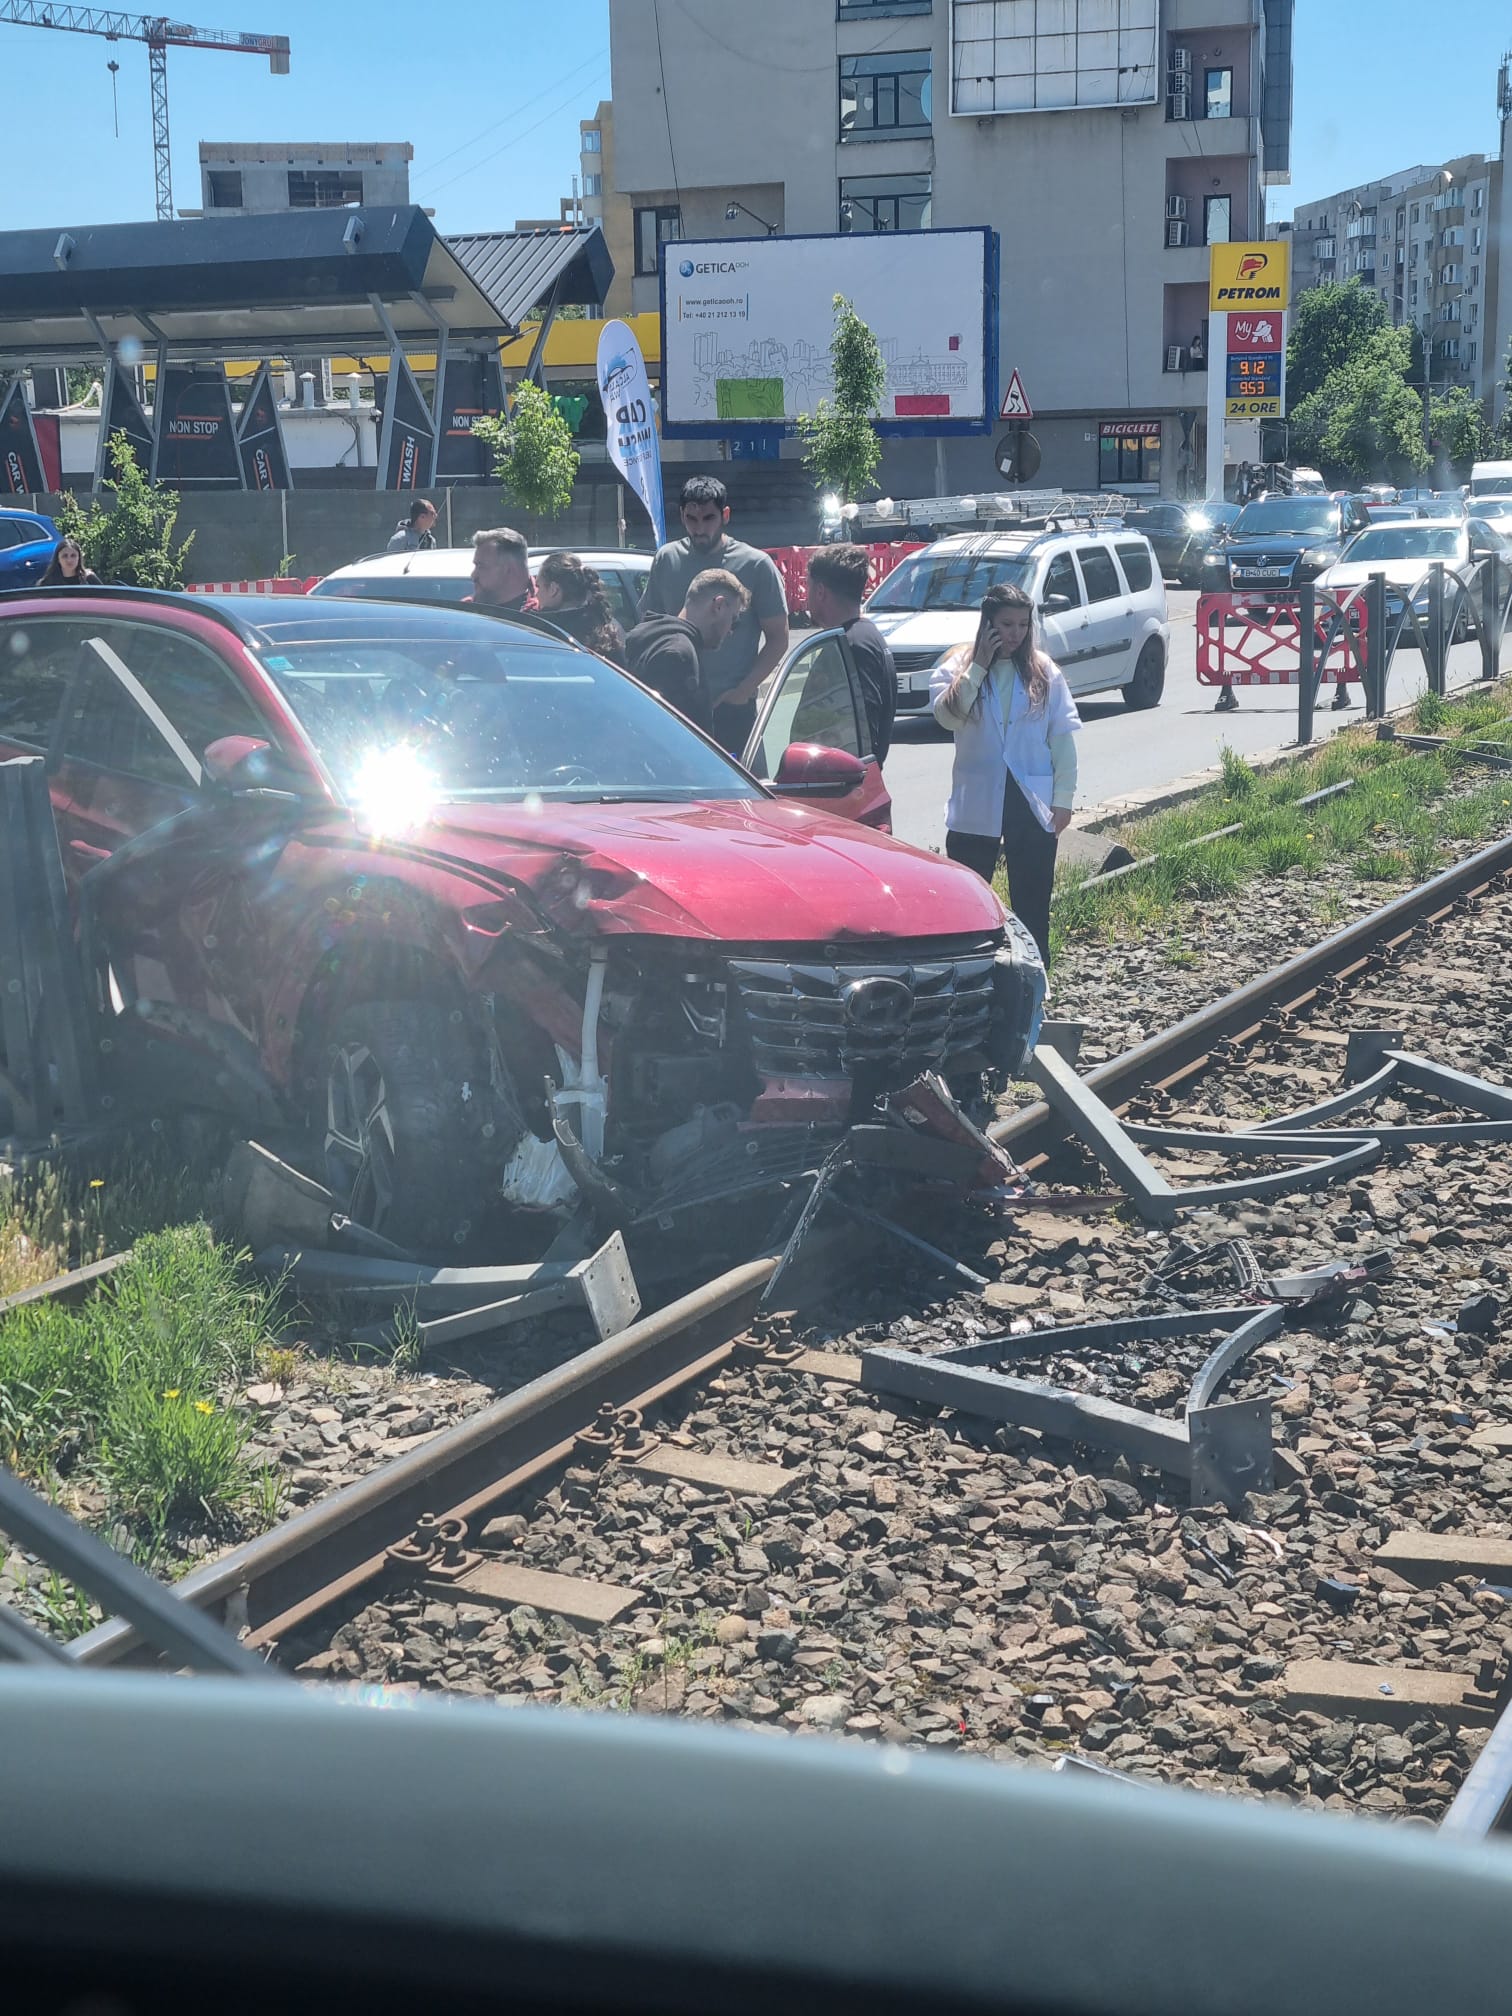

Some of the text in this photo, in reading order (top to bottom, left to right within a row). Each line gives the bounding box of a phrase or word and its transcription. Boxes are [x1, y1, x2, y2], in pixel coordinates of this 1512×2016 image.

[695, 263, 736, 274] GETICA
[1217, 287, 1280, 299] PETROM
[685, 298, 744, 306] www.geticaooh.ro
[1235, 321, 1253, 341] My
[1230, 402, 1277, 414] 24 ORE
[169, 421, 219, 434] NON STOP
[452, 415, 470, 428] NON
[1103, 423, 1159, 434] BICICLETE
[255, 448, 268, 480] CAR
[402, 436, 415, 482] WASH
[8, 451, 21, 481] CAR
